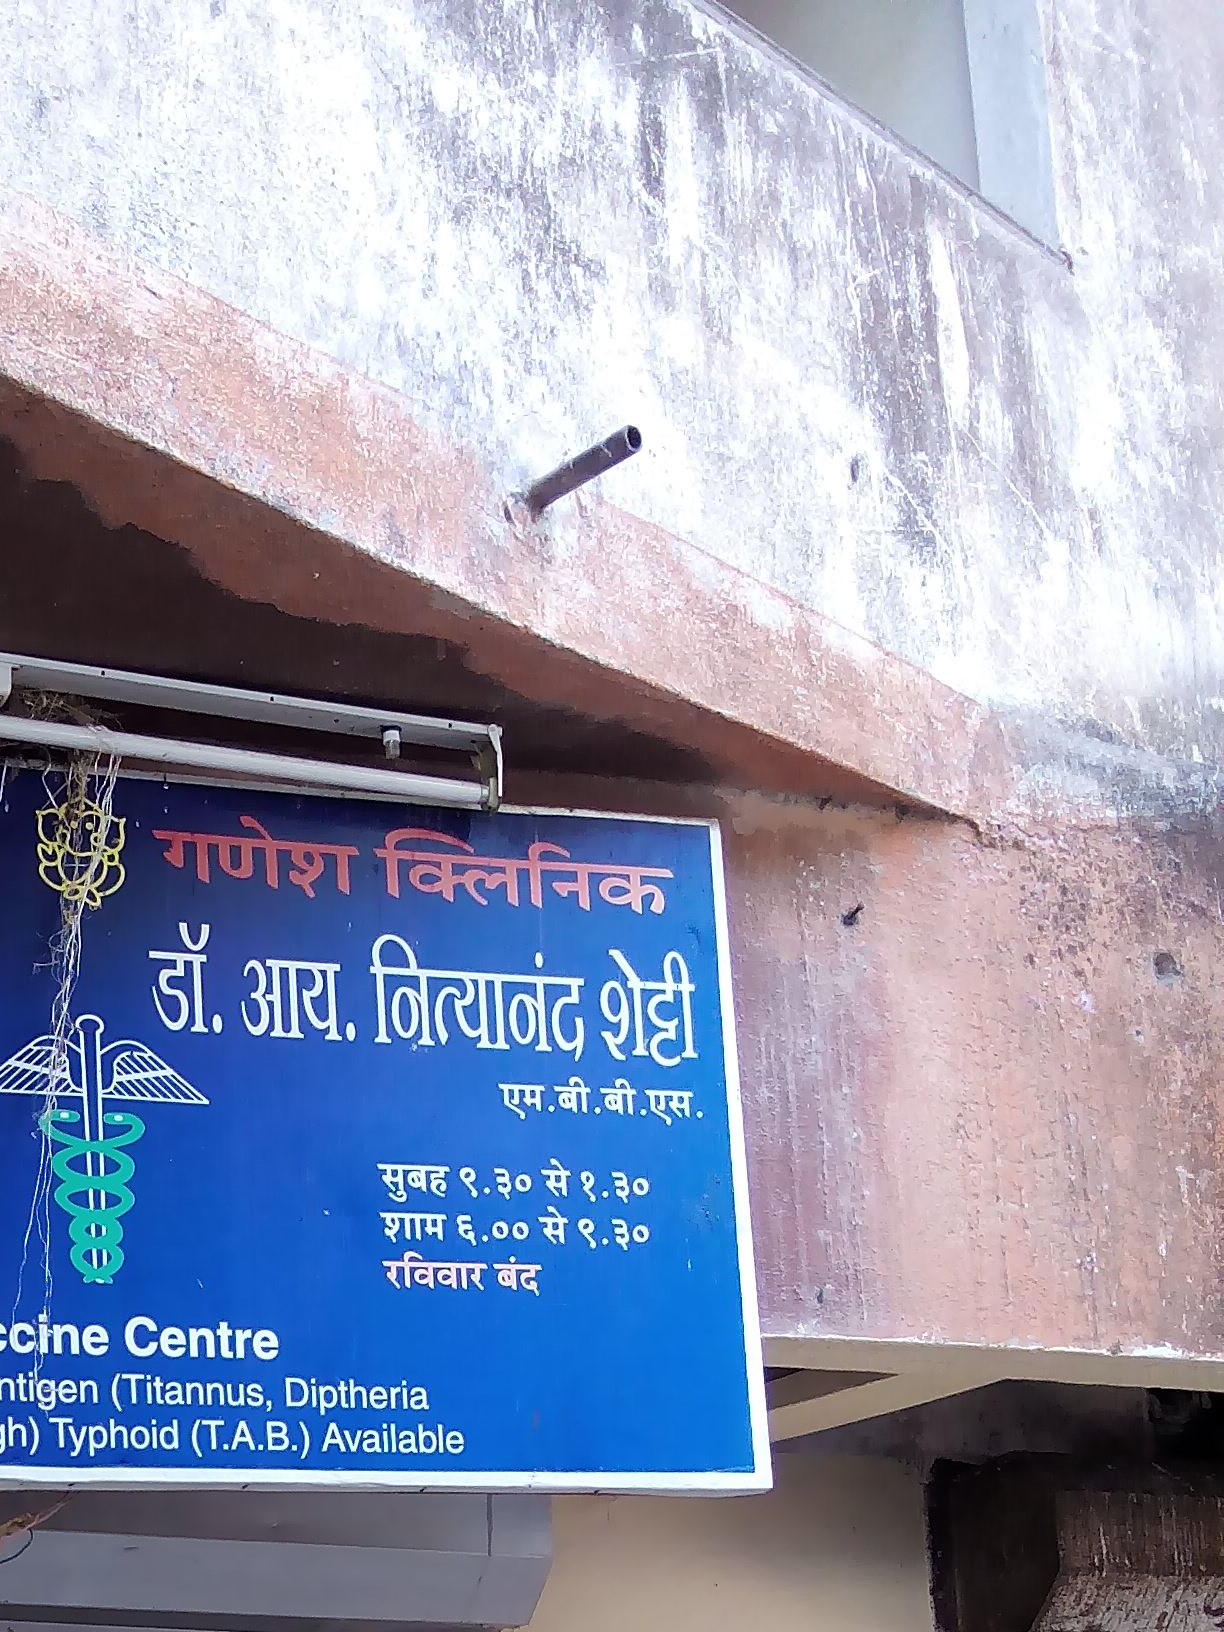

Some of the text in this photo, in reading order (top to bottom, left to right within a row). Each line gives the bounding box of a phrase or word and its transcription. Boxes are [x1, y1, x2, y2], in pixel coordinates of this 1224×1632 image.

[152, 815, 674, 915] गणेश क्लिनिक
[149, 922, 699, 1068] डॉ. आय. नित्यानंद शेट्टी
[377, 1162, 449, 1203] सुबह
[459, 1165, 533, 1199] ९.३०
[542, 1157, 571, 1197] से
[380, 1210, 445, 1243] शाम
[456, 1213, 530, 1246] ६.००
[539, 1205, 569, 1245] से
[382, 1251, 542, 1297] रविवार बंद
[125, 1316, 279, 1361] Centre
[111, 1374, 274, 1412] (Titannus,
[285, 1379, 429, 1418] Diptheria
[49, 1417, 178, 1458] Typhoid
[191, 1420, 310, 1460] (T.A.B.)
[322, 1422, 465, 1457] Available
